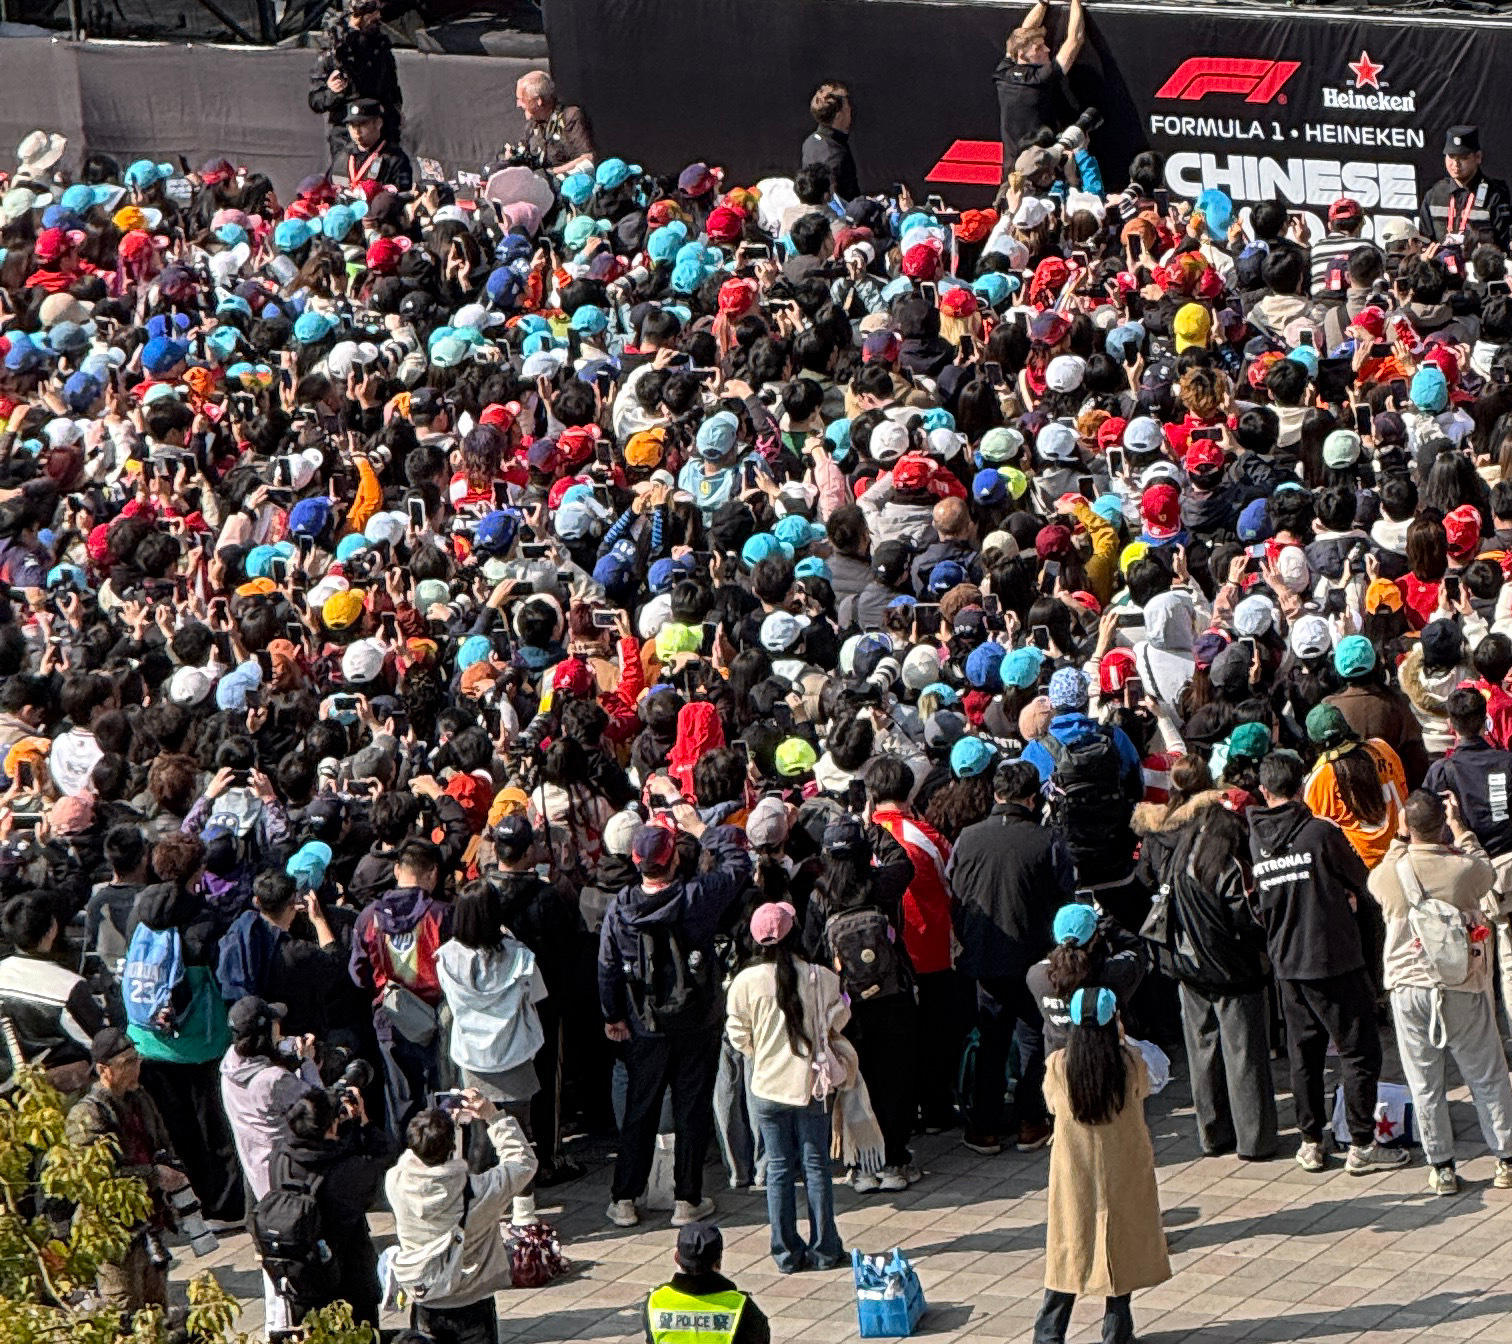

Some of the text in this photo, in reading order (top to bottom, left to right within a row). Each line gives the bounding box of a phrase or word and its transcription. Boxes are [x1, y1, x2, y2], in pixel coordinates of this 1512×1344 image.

[1322, 88, 1416, 112] Heineken
[1150, 115, 1425, 149] FORMULA 1 HEINEKEN
[1164, 152, 1419, 210] CHINESE
[675, 1314, 711, 1328] POLICE
